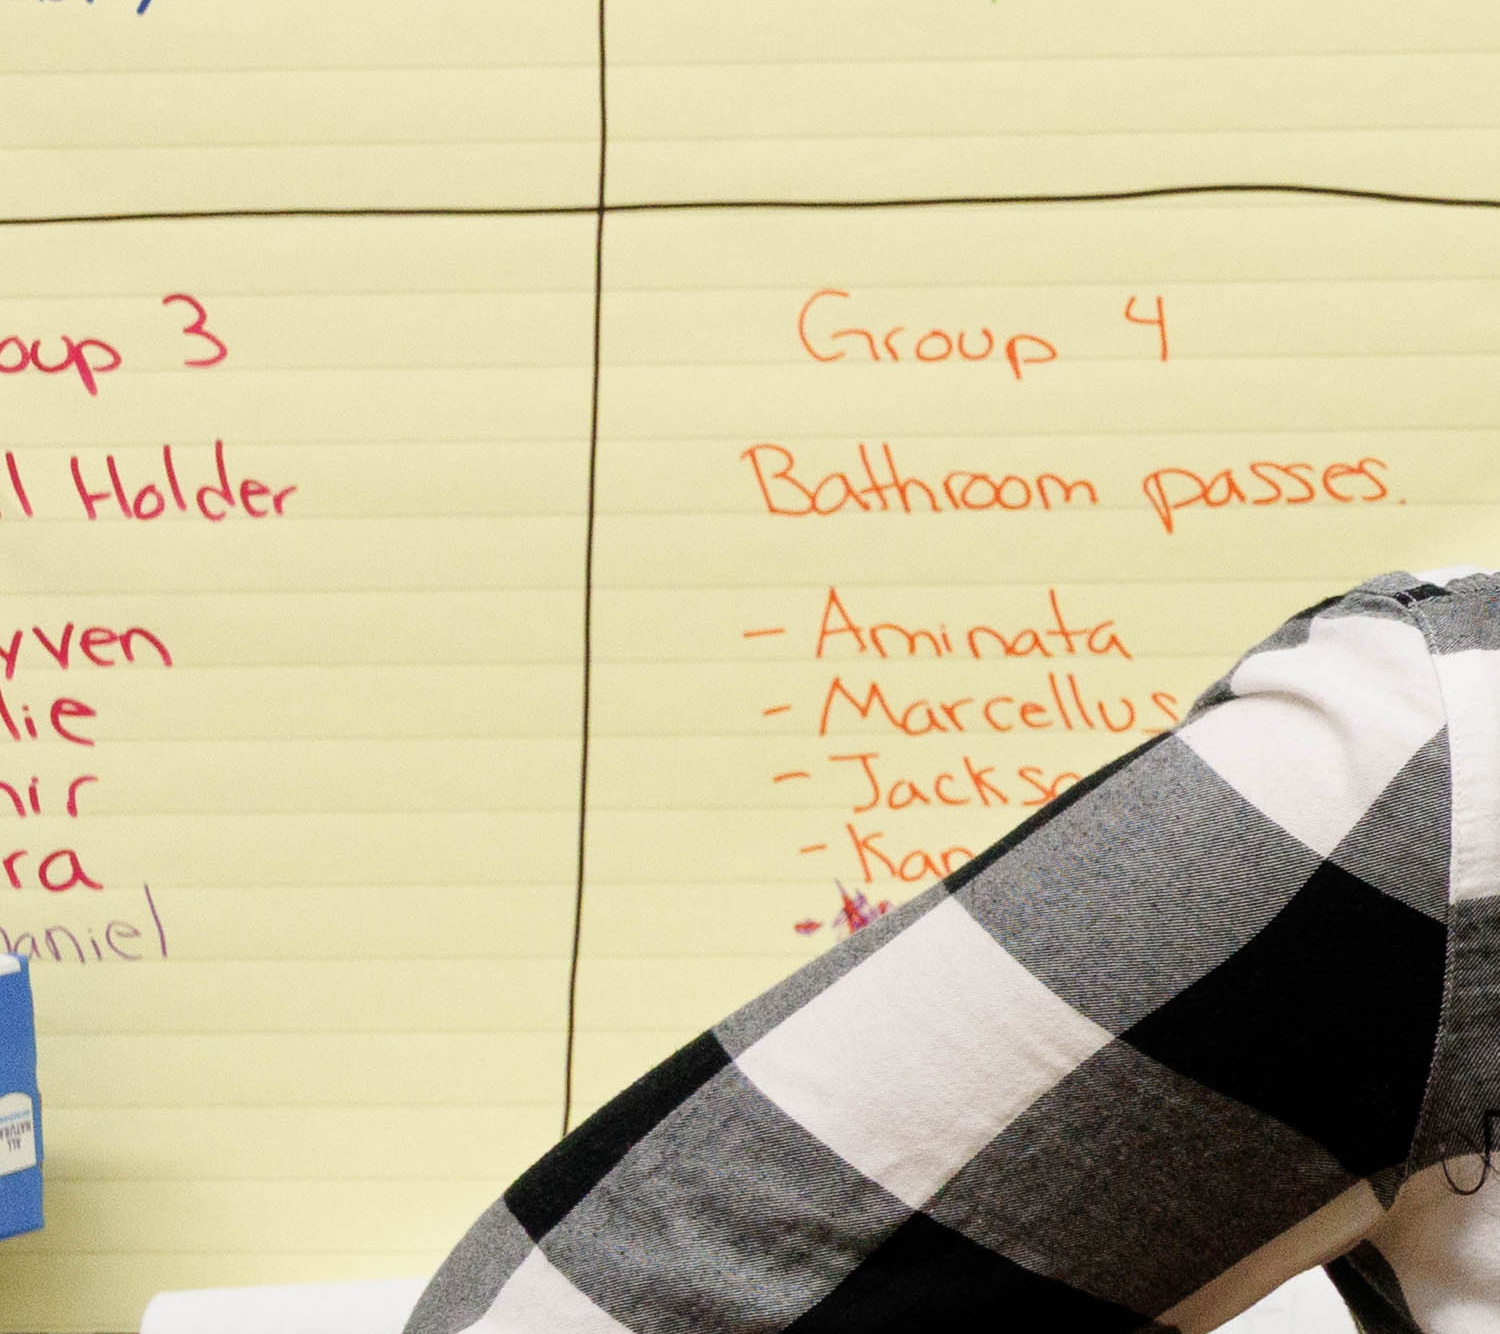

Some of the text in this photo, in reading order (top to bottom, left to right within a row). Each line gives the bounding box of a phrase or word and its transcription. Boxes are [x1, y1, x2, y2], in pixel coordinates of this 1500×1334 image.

[162, 293, 229, 368] 3
[798, 287, 1169, 381] Group 4
[70, 439, 298, 521] Holder
[741, 442, 1100, 516] Bathroom
[815, 586, 1133, 660] Aminata
[819, 672, 1180, 737] Marcellus
